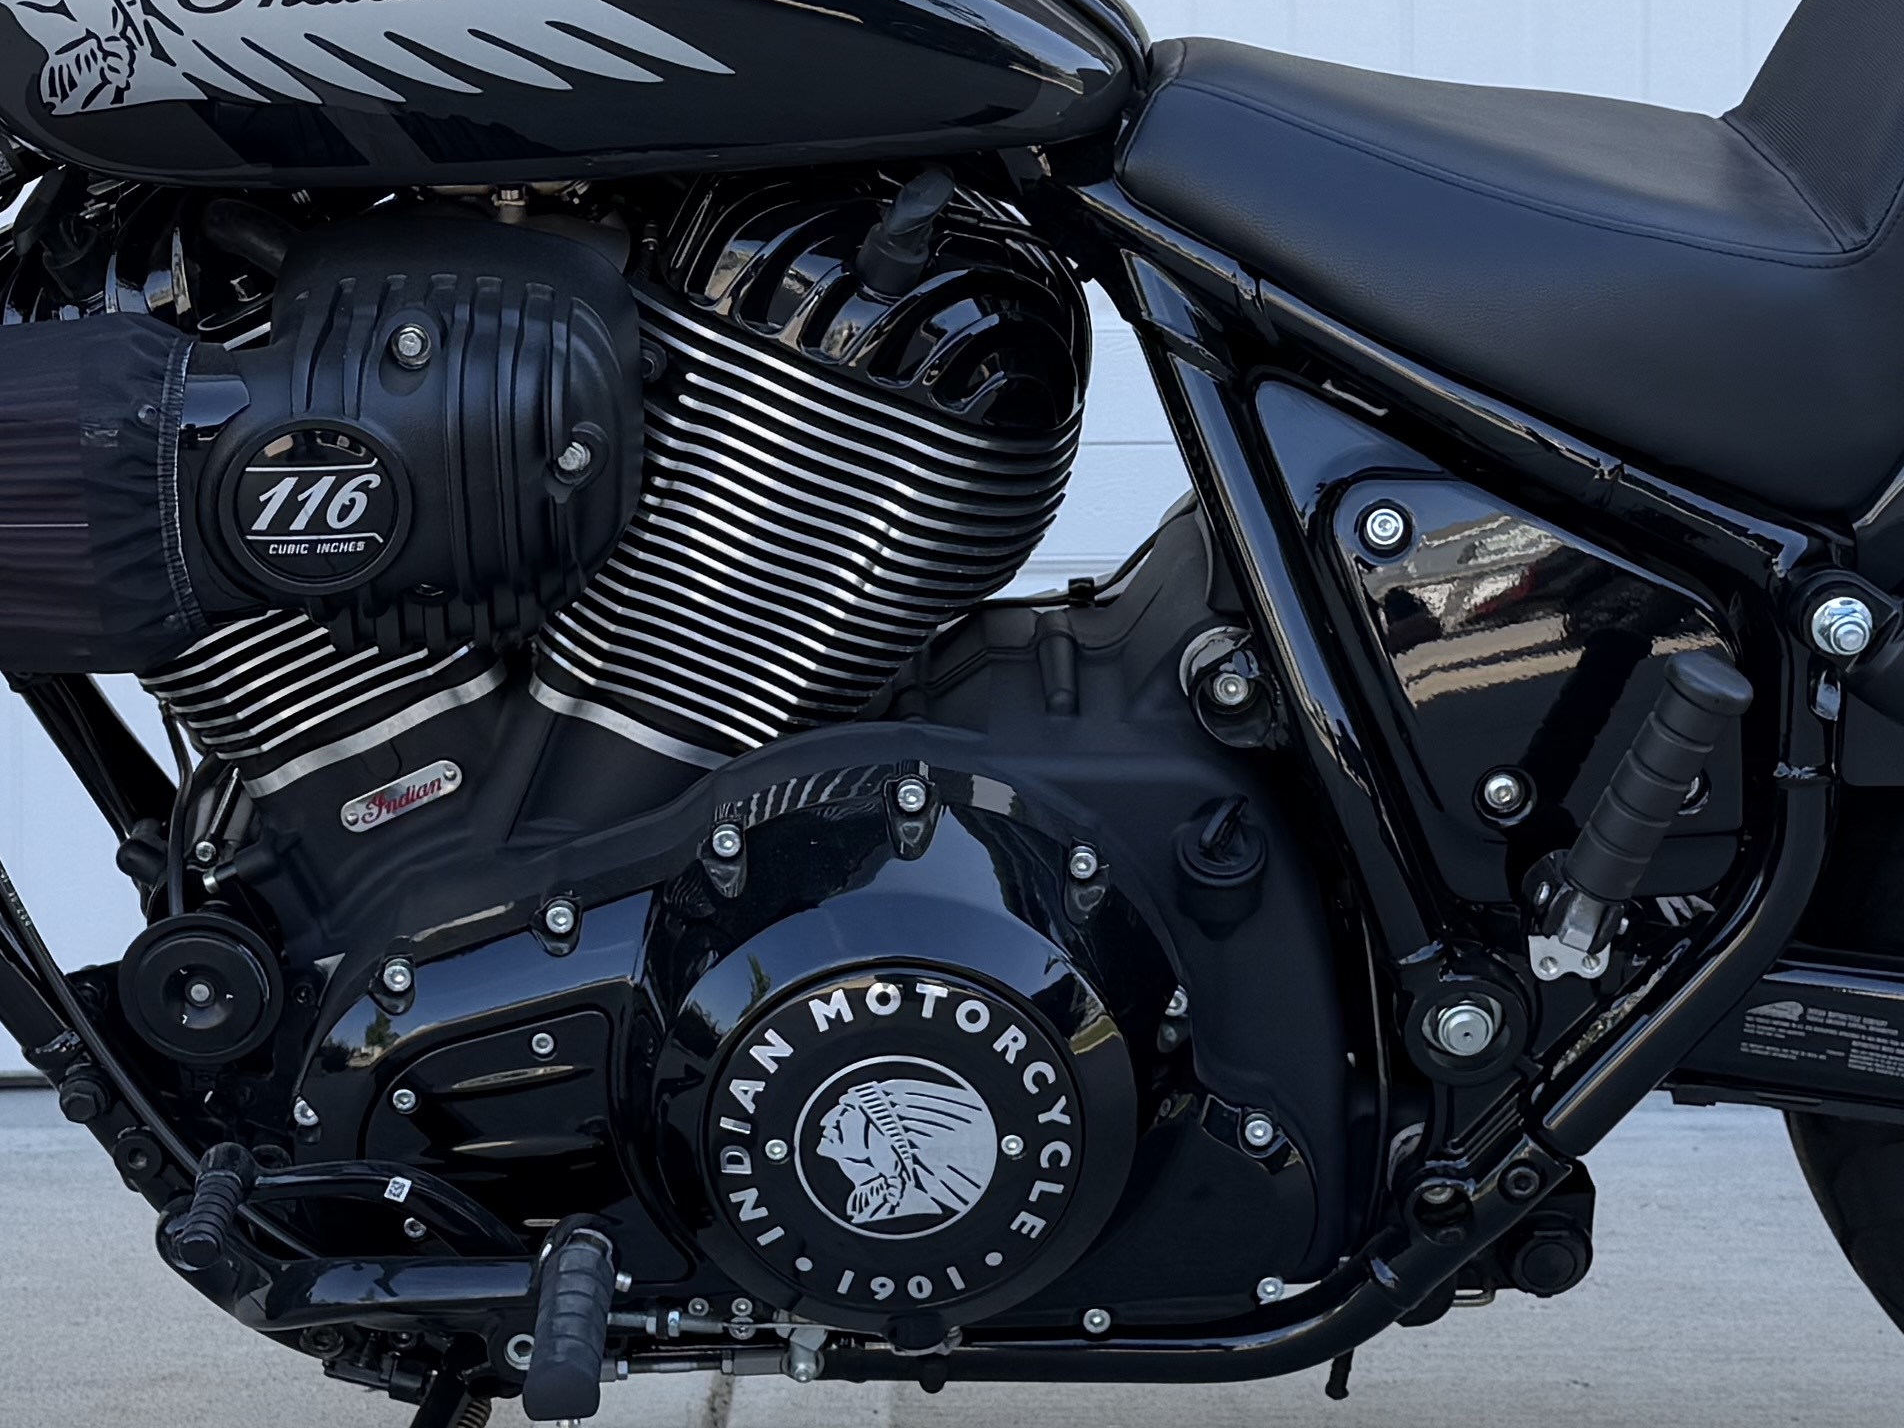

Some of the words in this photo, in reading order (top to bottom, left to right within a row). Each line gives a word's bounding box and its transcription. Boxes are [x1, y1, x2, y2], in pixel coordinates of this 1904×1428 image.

[251, 473, 381, 531] 116
[269, 543, 309, 555] CUBIC
[316, 541, 366, 554] INCHES
[361, 775, 443, 824] Indian
[719, 1028, 794, 1247] INDIAN
[807, 982, 1072, 1240] MOTORCYCLE
[837, 1265, 966, 1301] 1901
